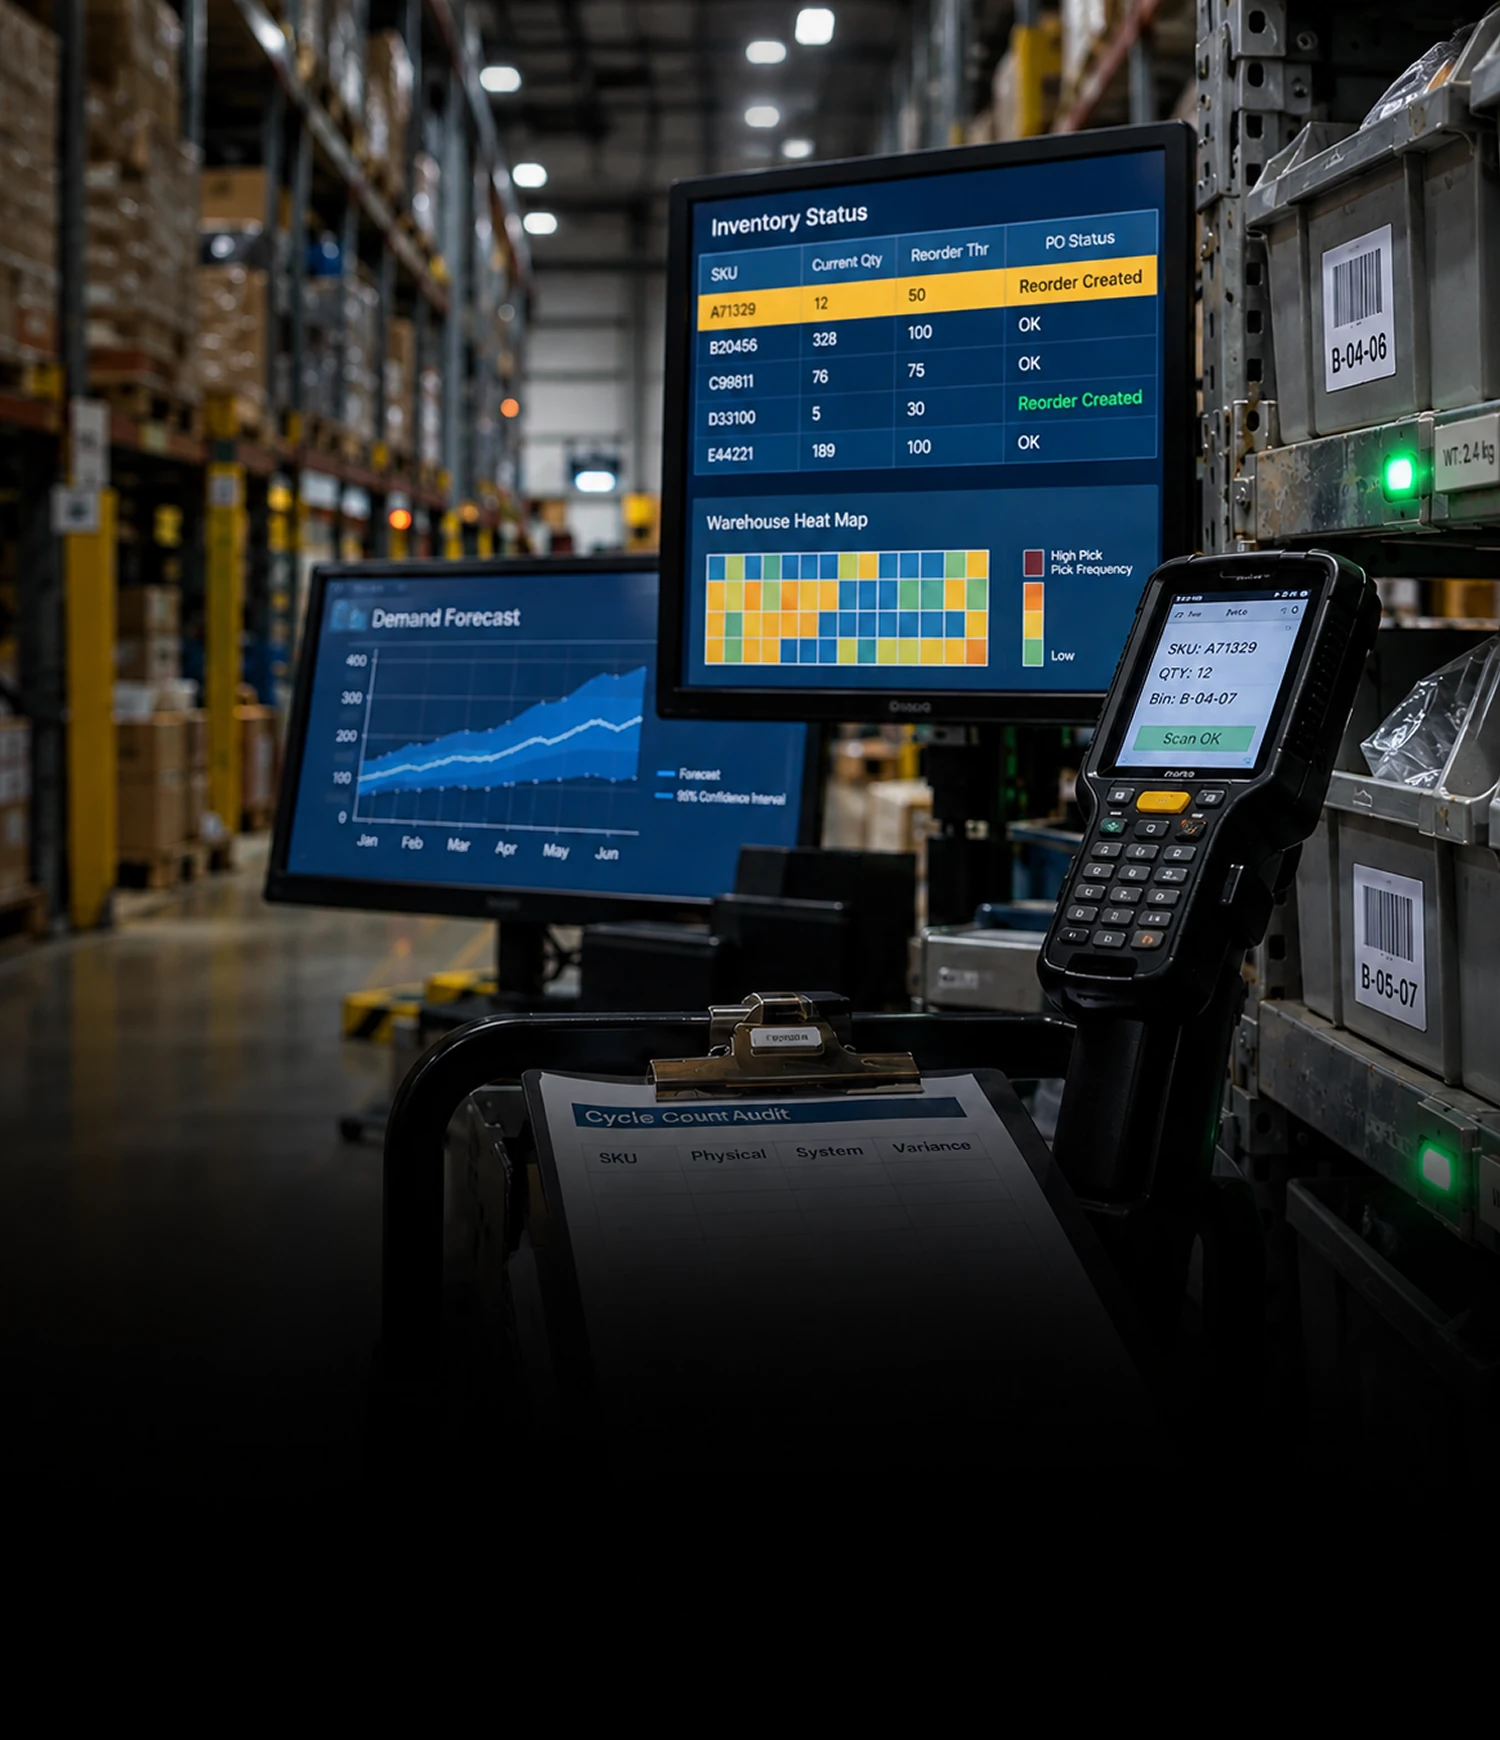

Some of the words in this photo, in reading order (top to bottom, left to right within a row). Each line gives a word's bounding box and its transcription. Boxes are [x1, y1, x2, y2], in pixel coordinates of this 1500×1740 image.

[711, 212, 801, 237] Inventory
[805, 205, 868, 227] Status
[711, 266, 738, 282] SKU
[812, 256, 858, 272] Current
[861, 253, 882, 269] Qty
[911, 244, 963, 262] Reorder
[967, 242, 989, 257] Thr
[1045, 235, 1066, 250] PO
[1069, 232, 1116, 248] Status
[710, 302, 756, 319] A71329
[814, 296, 829, 310] 12
[908, 287, 926, 302] 50
[1019, 276, 1078, 294] Reorder
[1082, 269, 1143, 289] Created
[710, 338, 758, 355] B20456
[812, 332, 837, 347] 328
[908, 324, 933, 340] 100
[1018, 317, 1041, 332] OK
[1331, 332, 1387, 374] B-04-06
[709, 374, 754, 390] C99811
[812, 369, 829, 384] 76
[907, 363, 925, 378] 75
[1018, 356, 1041, 371] OK
[708, 410, 756, 426] D33100
[812, 406, 821, 421] 5
[907, 401, 925, 416] 30
[1018, 396, 1078, 411] Reorder
[1082, 389, 1143, 407] Created
[708, 447, 754, 462] E44221
[812, 443, 835, 458] 189
[907, 439, 932, 454] 100
[1017, 435, 1040, 450] OK
[1482, 440, 1495, 465] kg
[706, 514, 790, 531] Warehouse
[794, 512, 831, 529] Heat
[834, 512, 868, 531] Map
[1051, 550, 1076, 564] High
[1079, 549, 1103, 561] Pick
[1051, 564, 1074, 575] Pick
[1076, 564, 1133, 577] Frequency
[371, 608, 443, 628] Demand
[444, 608, 521, 628] Forecast
[1051, 650, 1075, 661] Low
[1167, 643, 1202, 655] SKU:
[1204, 641, 1258, 655] A71329
[345, 654, 367, 667] 400
[1159, 667, 1193, 682] QTY:
[1197, 667, 1213, 679] 12
[341, 691, 362, 705] 300
[1149, 693, 1176, 705] Bin:
[1179, 692, 1238, 705] B-04-07
[336, 730, 358, 743] 200
[1162, 732, 1197, 745] Scan
[1199, 733, 1222, 745] OK
[333, 771, 352, 785] 100
[338, 811, 347, 824] 0
[357, 834, 378, 847] Jan
[402, 836, 424, 850] Feb
[447, 838, 471, 852] Mar
[495, 841, 518, 858] Apr
[543, 843, 570, 861] May
[595, 847, 619, 861] Jun
[1361, 962, 1418, 1008] B-05-07
[585, 1110, 655, 1128] Cycle
[661, 1111, 730, 1123] Count
[732, 1107, 792, 1122] Audit
[599, 1152, 637, 1164] SKU
[691, 1149, 767, 1163] Physical
[796, 1146, 864, 1160] System
[892, 1141, 972, 1153] Variance
